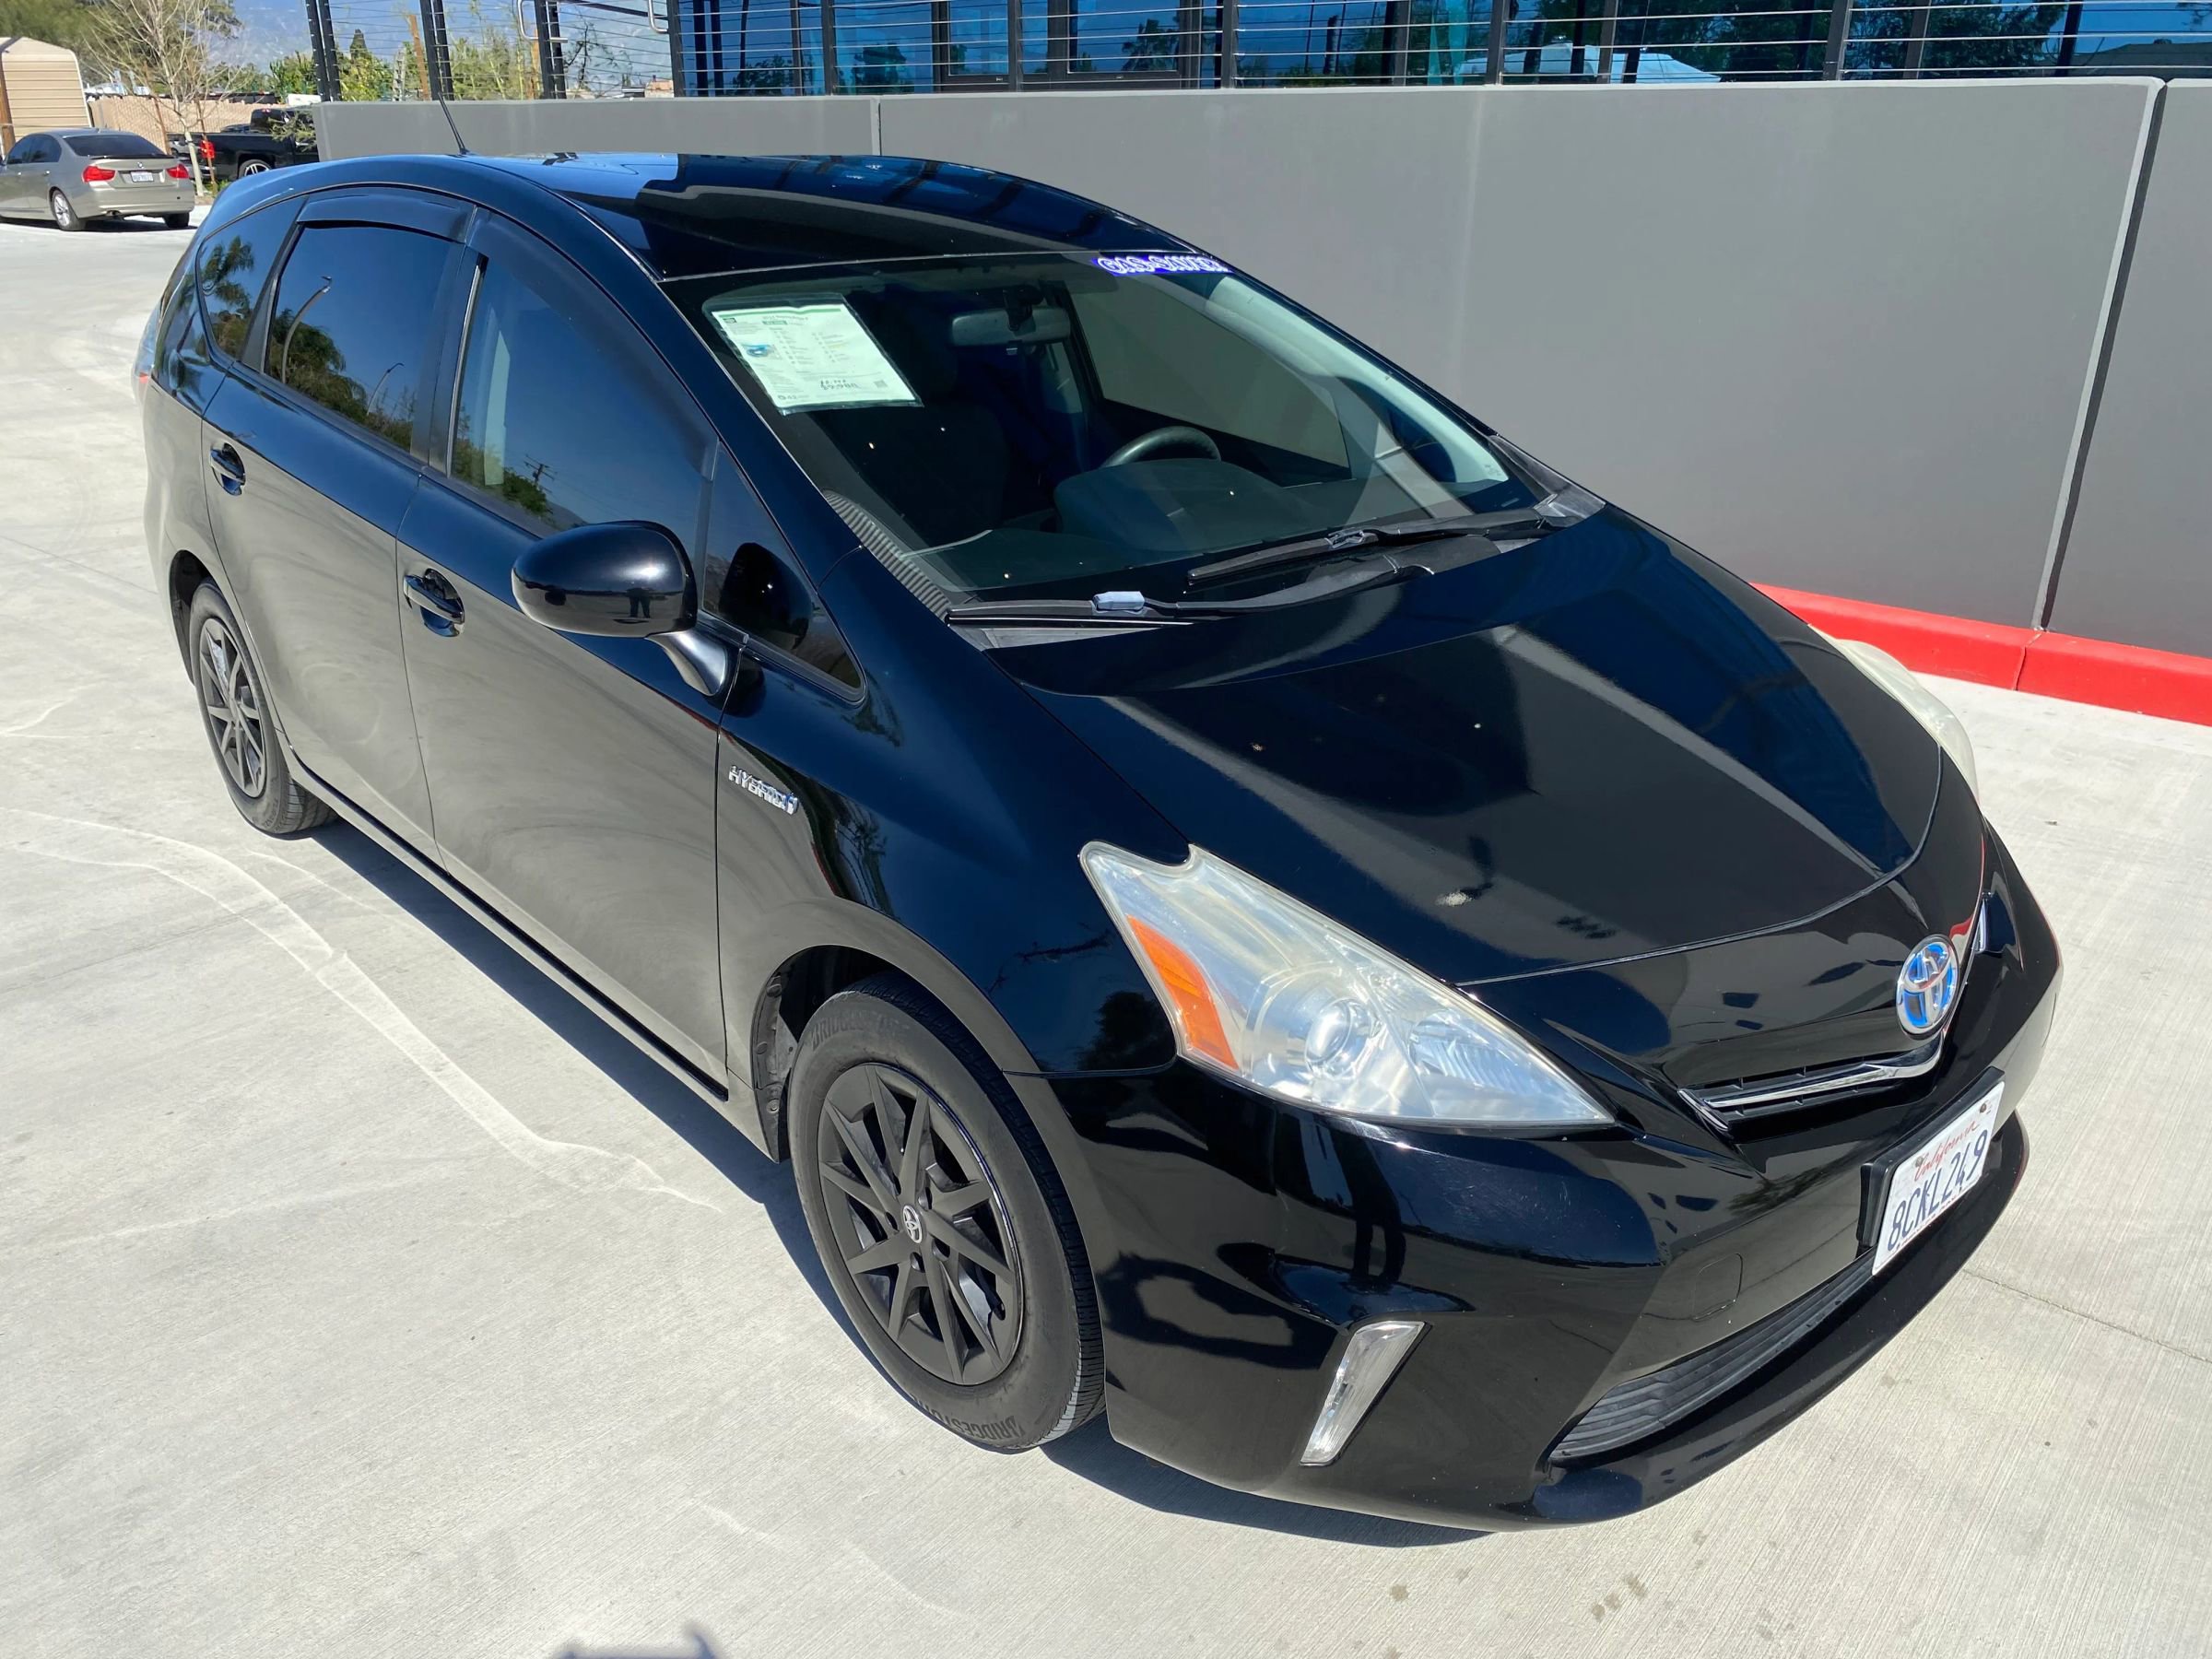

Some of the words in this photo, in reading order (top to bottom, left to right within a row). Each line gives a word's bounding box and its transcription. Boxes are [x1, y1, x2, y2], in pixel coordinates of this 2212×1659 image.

[728, 765, 798, 815] HYBRID
[1914, 1121, 1979, 1182] California
[1887, 1129, 1988, 1253] 8CKL249
